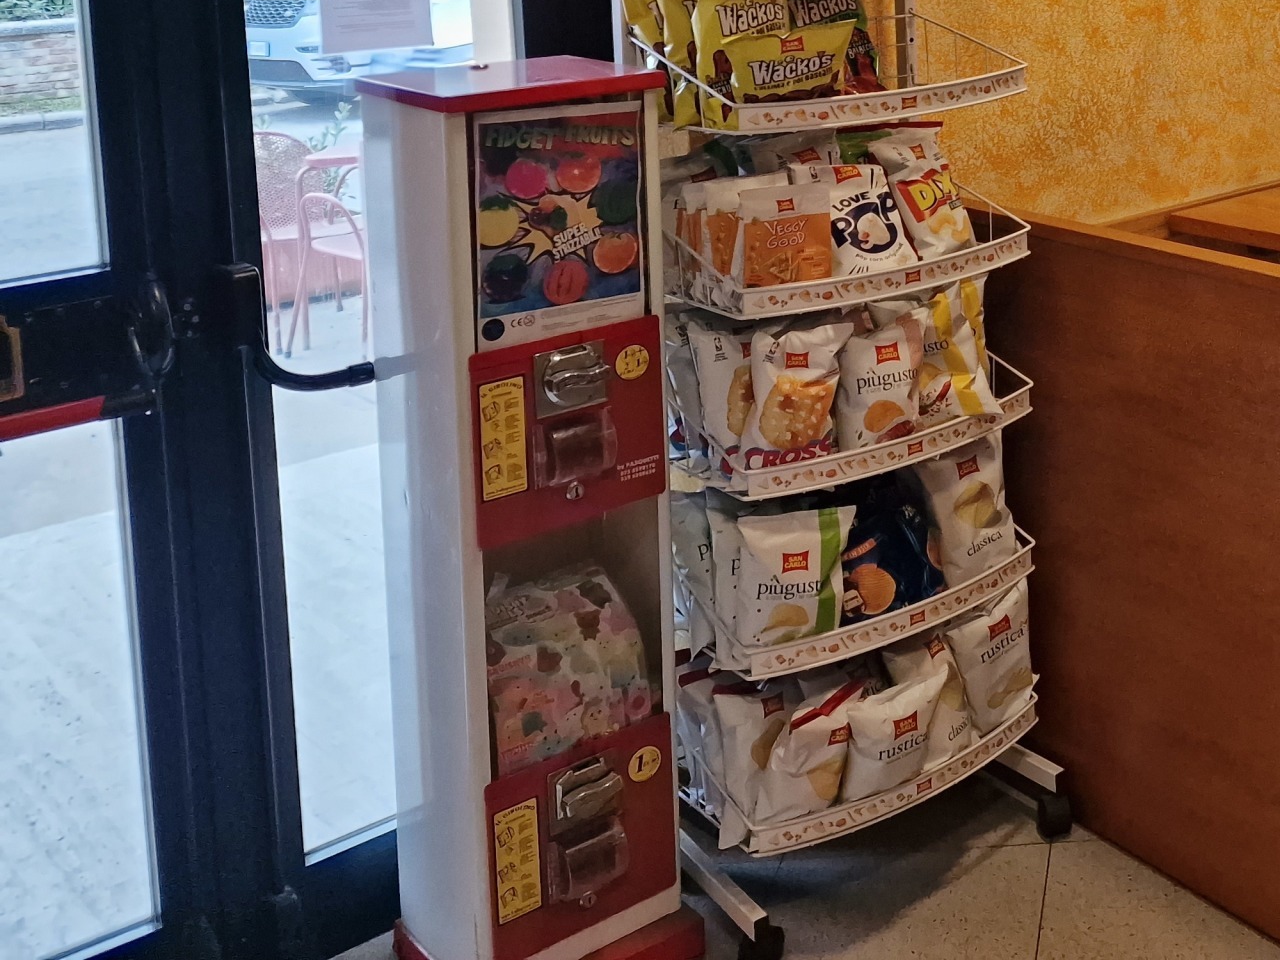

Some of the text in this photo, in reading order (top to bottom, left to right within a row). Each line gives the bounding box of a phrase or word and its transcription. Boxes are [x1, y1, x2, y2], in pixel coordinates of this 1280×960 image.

[485, 125, 635, 150] FIDGET FRUITS
[832, 191, 871, 212] LOVE
[553, 222, 588, 246] SUPER
[764, 218, 806, 235] VEGGY
[831, 191, 899, 254] POP
[767, 232, 806, 248] GOOD
[878, 351, 898, 360] CARLO
[856, 367, 918, 395] piùgusto
[967, 531, 1003, 558] classica
[784, 560, 807, 569] CARLO
[757, 575, 822, 600] piùgust
[980, 627, 1025, 663] rustica
[878, 732, 929, 761] rustica
